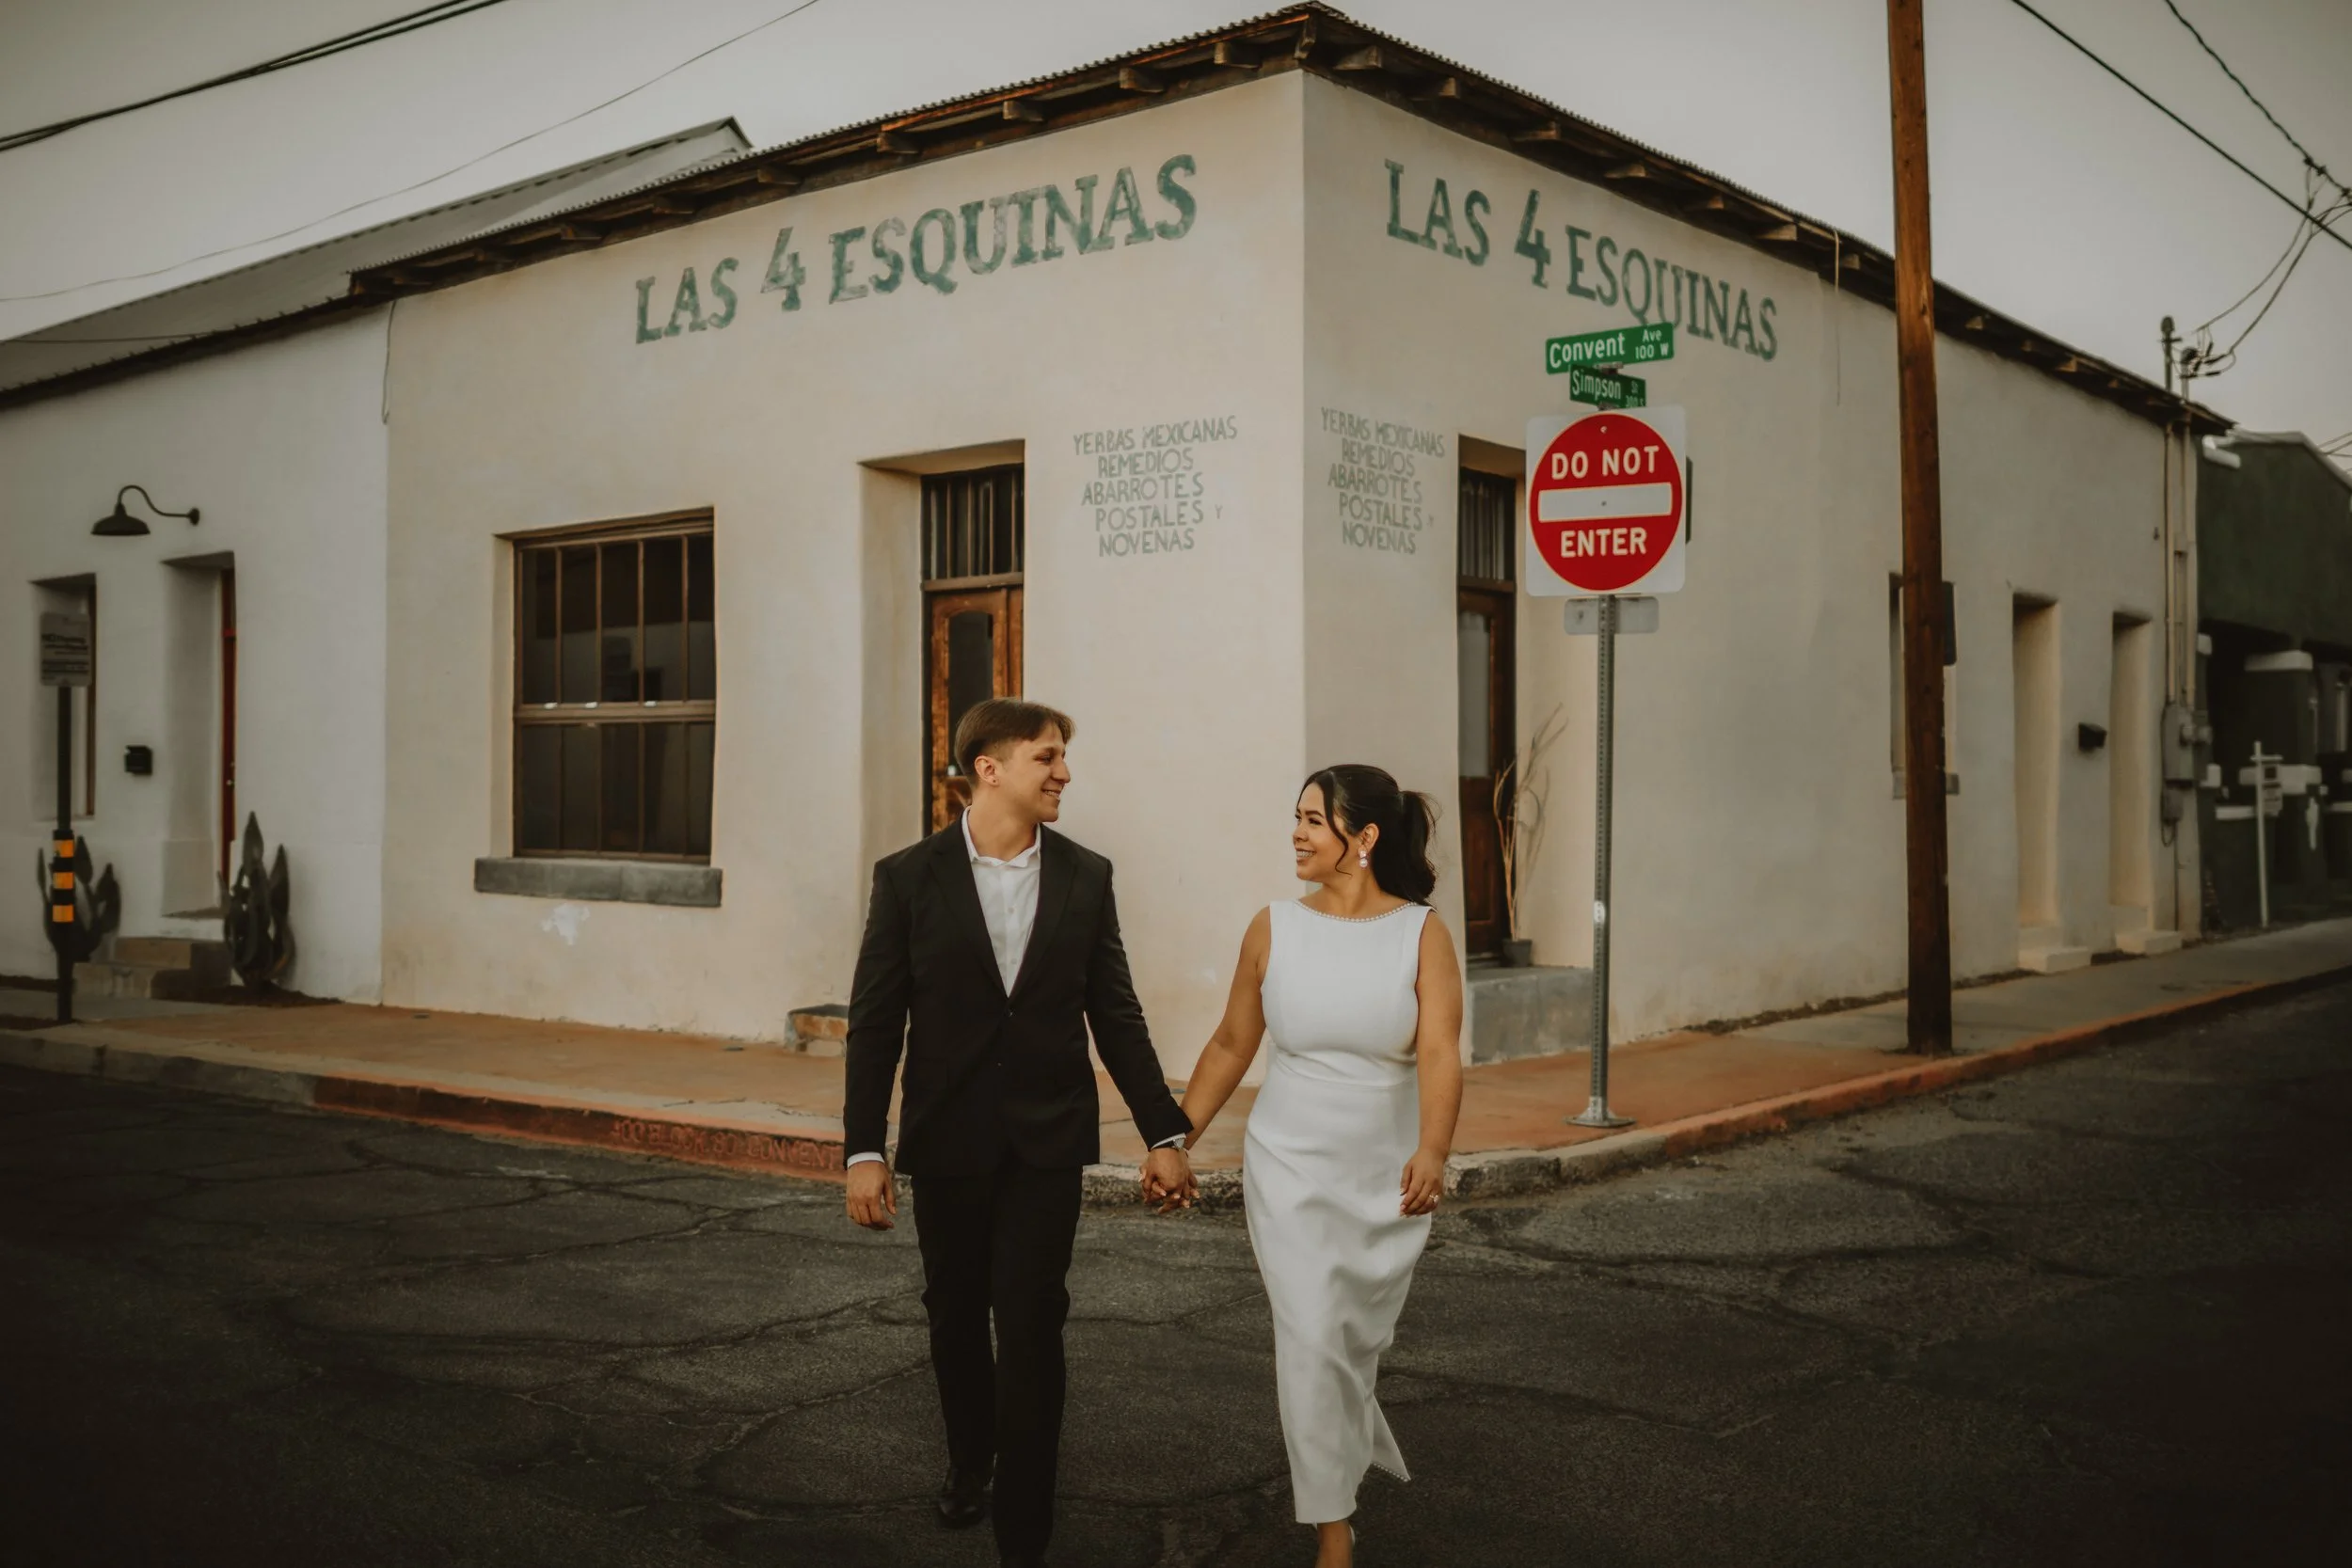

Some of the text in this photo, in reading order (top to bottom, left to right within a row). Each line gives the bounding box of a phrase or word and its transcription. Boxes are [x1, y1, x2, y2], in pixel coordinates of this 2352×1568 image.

[635, 154, 1198, 344] LAS 4 ESQUINAS
[1384, 159, 1779, 362] LAS 4 ESQUINAS
[1549, 329, 1662, 369] Convent Ave
[1635, 342, 1669, 359] 100 W
[1572, 369, 1622, 401] Simpson
[1073, 415, 1238, 456] YERBAS MEXICANAS
[1321, 406, 1446, 459] YERBAS MEXICANAS
[1097, 447, 1194, 479] REMEDIOS
[1342, 437, 1416, 478] REMEDIOS
[1551, 445, 1660, 480] DO NOT
[1081, 472, 1204, 506] ABARROTES
[1327, 463, 1422, 504] ABARROTES
[1095, 500, 1204, 532] POSTALES
[1339, 492, 1422, 531] POSTALES
[1099, 528, 1195, 558] NOVENAS
[1343, 521, 1416, 555] NOVENAS
[1560, 527, 1647, 558] ENTER
[648, 1123, 706, 1158] BLOCK
[747, 1134, 843, 1170] CONVENT
